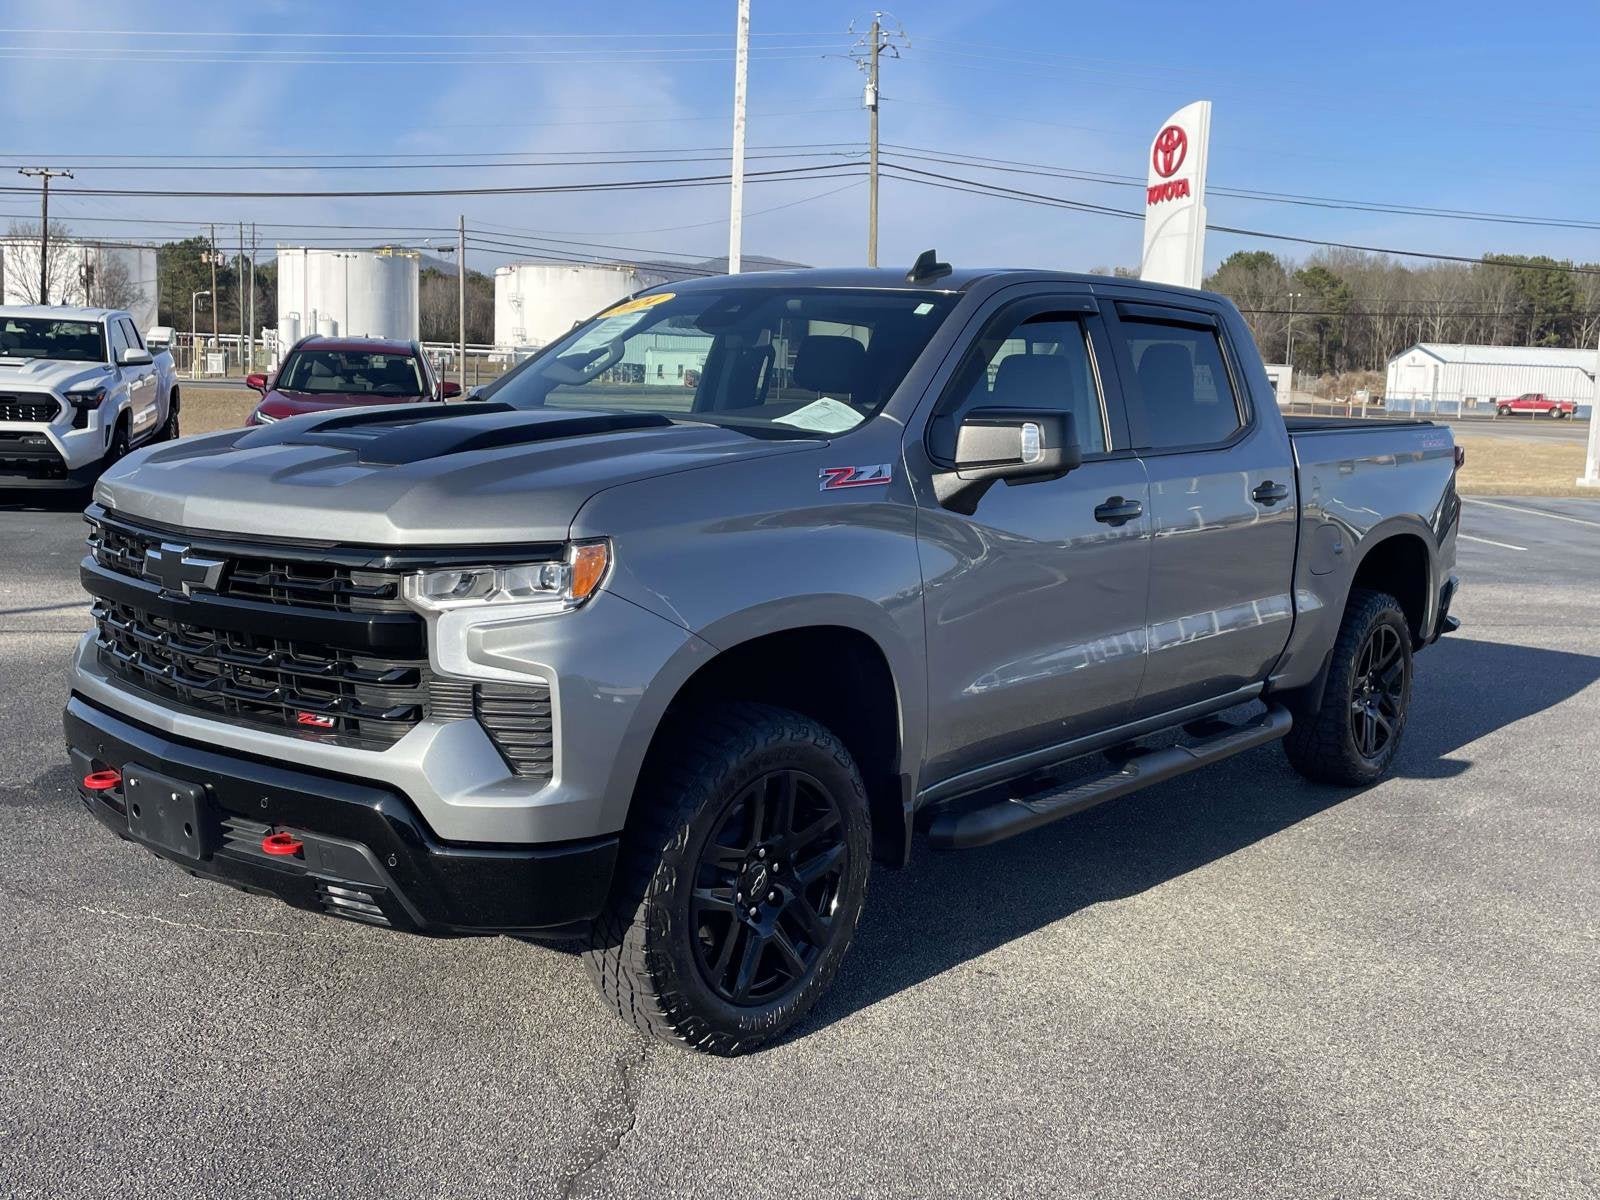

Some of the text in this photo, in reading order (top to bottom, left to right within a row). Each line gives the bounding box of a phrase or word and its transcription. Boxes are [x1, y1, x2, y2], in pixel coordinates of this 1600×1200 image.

[1147, 178, 1190, 206] TOYOTA
[819, 463, 892, 490] Z71
[298, 712, 335, 728] Z71
